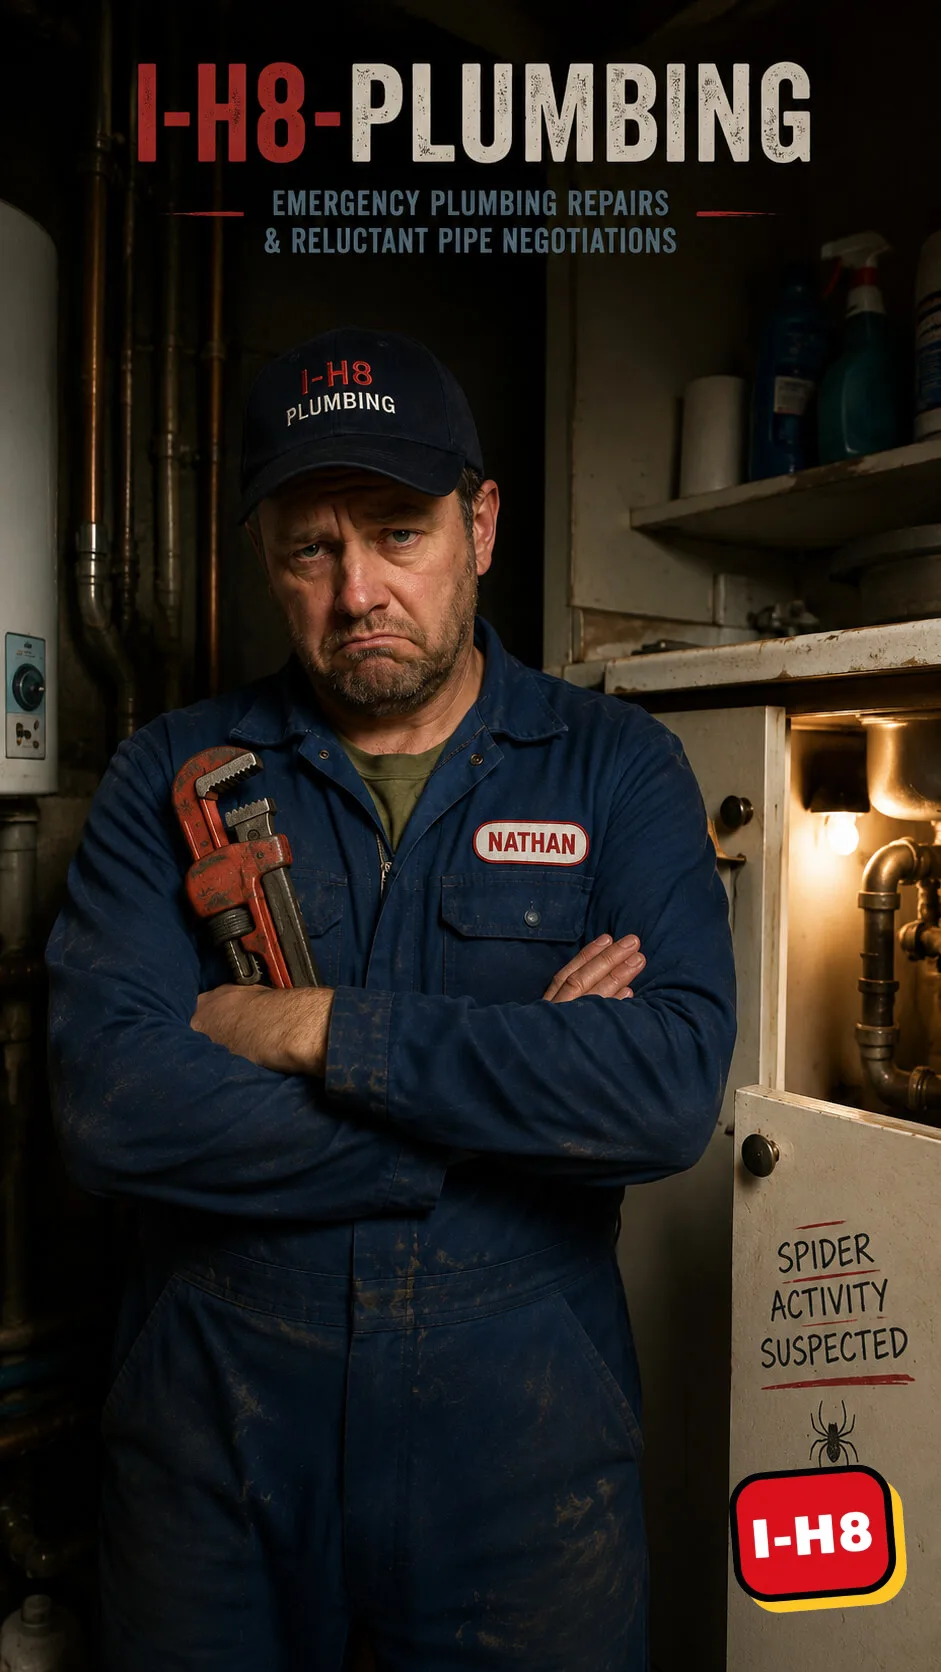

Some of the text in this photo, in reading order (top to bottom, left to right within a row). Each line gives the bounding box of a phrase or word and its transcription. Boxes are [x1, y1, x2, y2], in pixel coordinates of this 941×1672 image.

[301, 359, 374, 396] I-H8
[286, 391, 396, 426] PLUMBING
[488, 831, 576, 855] NATHAN
[777, 1232, 875, 1273] SPIDER
[770, 1278, 888, 1322] ACTIVITY
[760, 1327, 908, 1368] SUSPECTED
